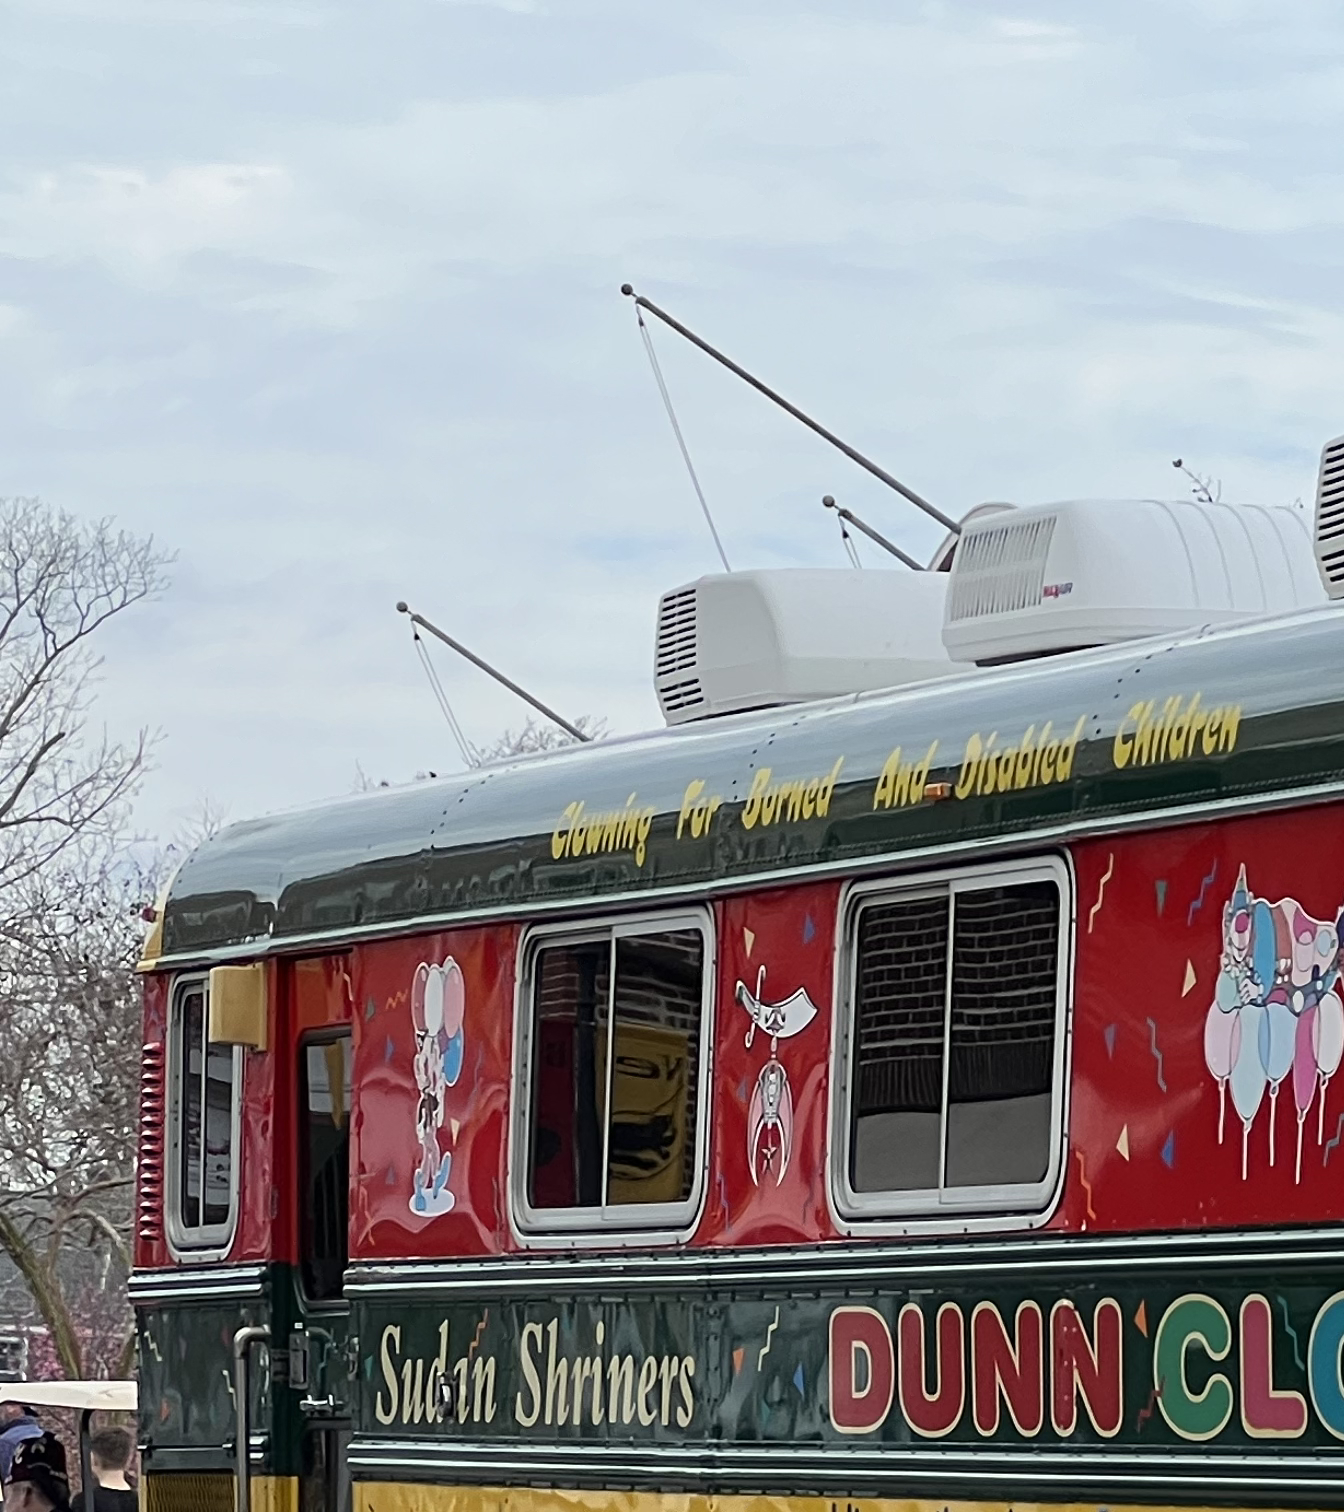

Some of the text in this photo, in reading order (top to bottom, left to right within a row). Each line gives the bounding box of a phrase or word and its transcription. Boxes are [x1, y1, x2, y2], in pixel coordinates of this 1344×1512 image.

[552, 691, 1241, 868] Clowning For Burned And Disabled Children
[514, 1317, 696, 1428] Shriners
[829, 1298, 1123, 1439] DUNN
